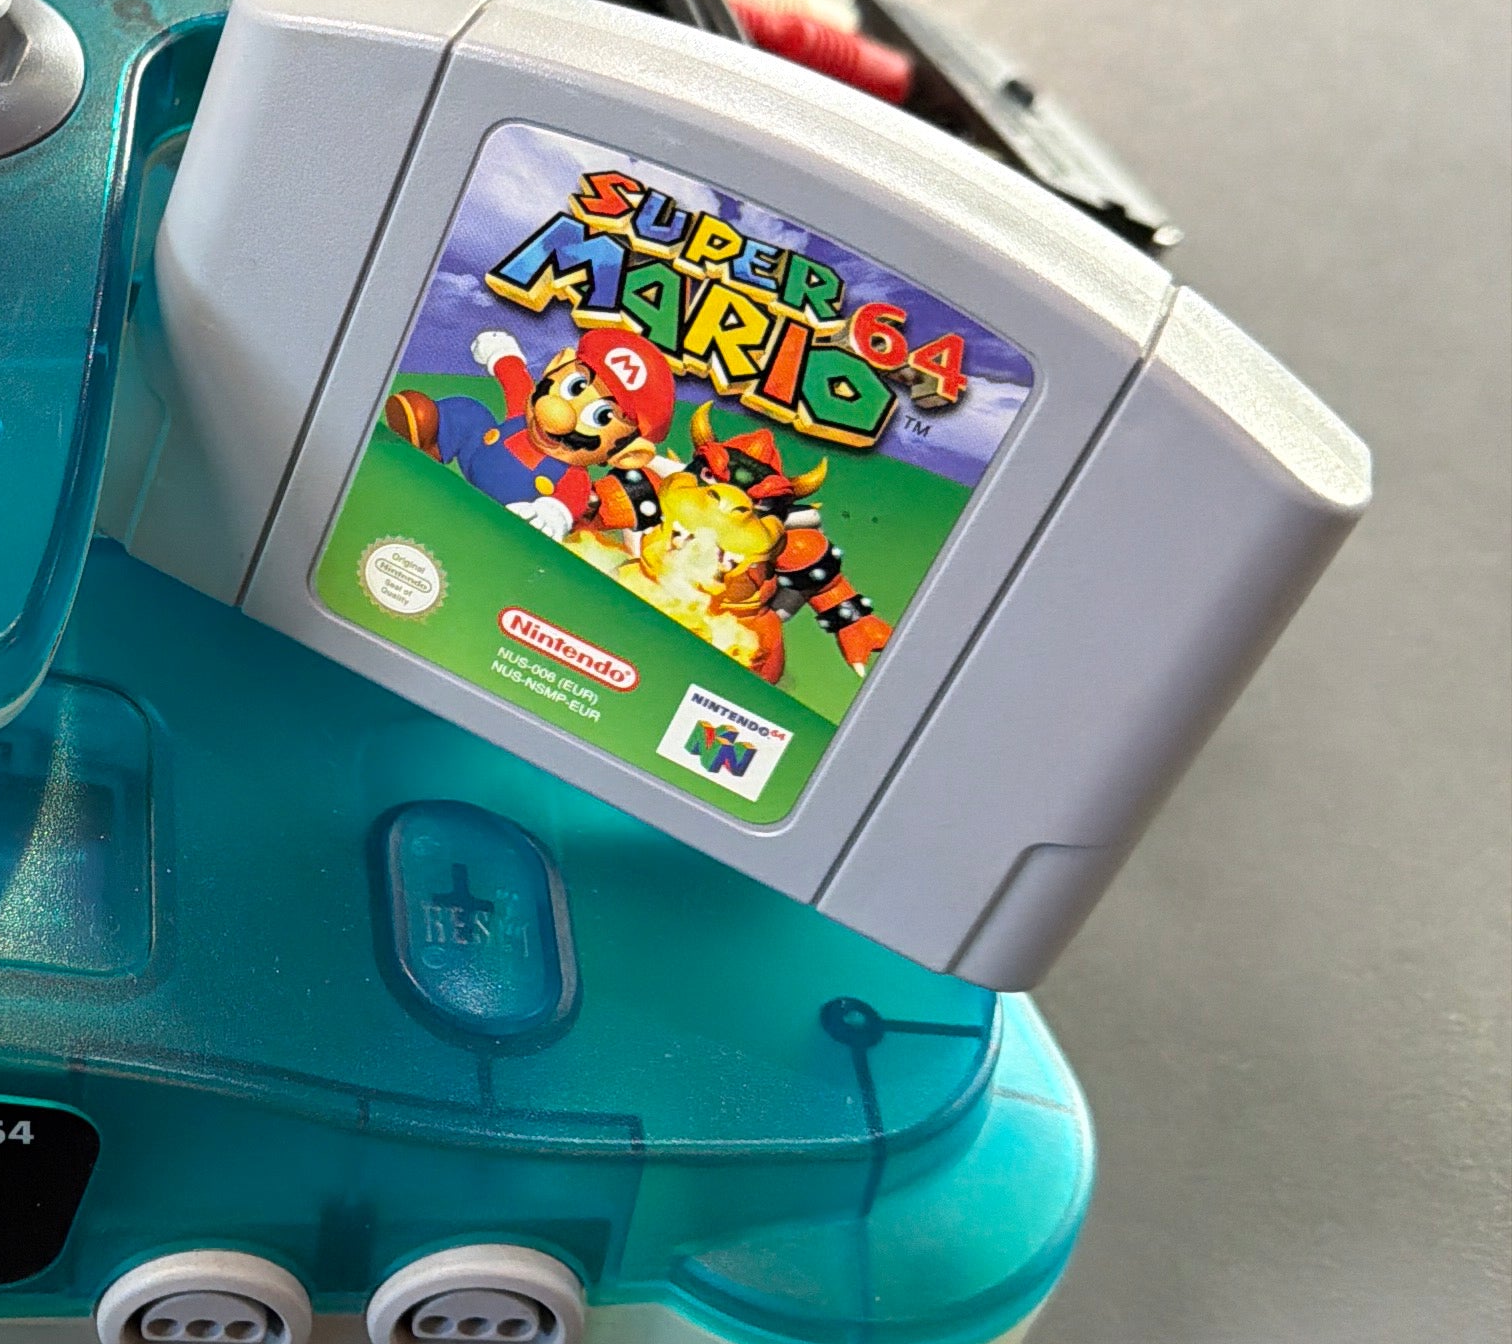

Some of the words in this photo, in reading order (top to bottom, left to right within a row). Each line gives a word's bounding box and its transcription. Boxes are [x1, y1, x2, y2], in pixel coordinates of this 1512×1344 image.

[570, 170, 845, 336] SUPER
[485, 213, 899, 447] MARIO
[848, 301, 968, 406] 64
[385, 578, 403, 592] Seal
[403, 588, 413, 597] of
[391, 552, 426, 575] Original
[381, 586, 409, 605] Quality
[491, 659, 601, 723] NUS-NSMP-EUR
[497, 646, 556, 683] NUS-006
[557, 677, 599, 706] (EUR)
